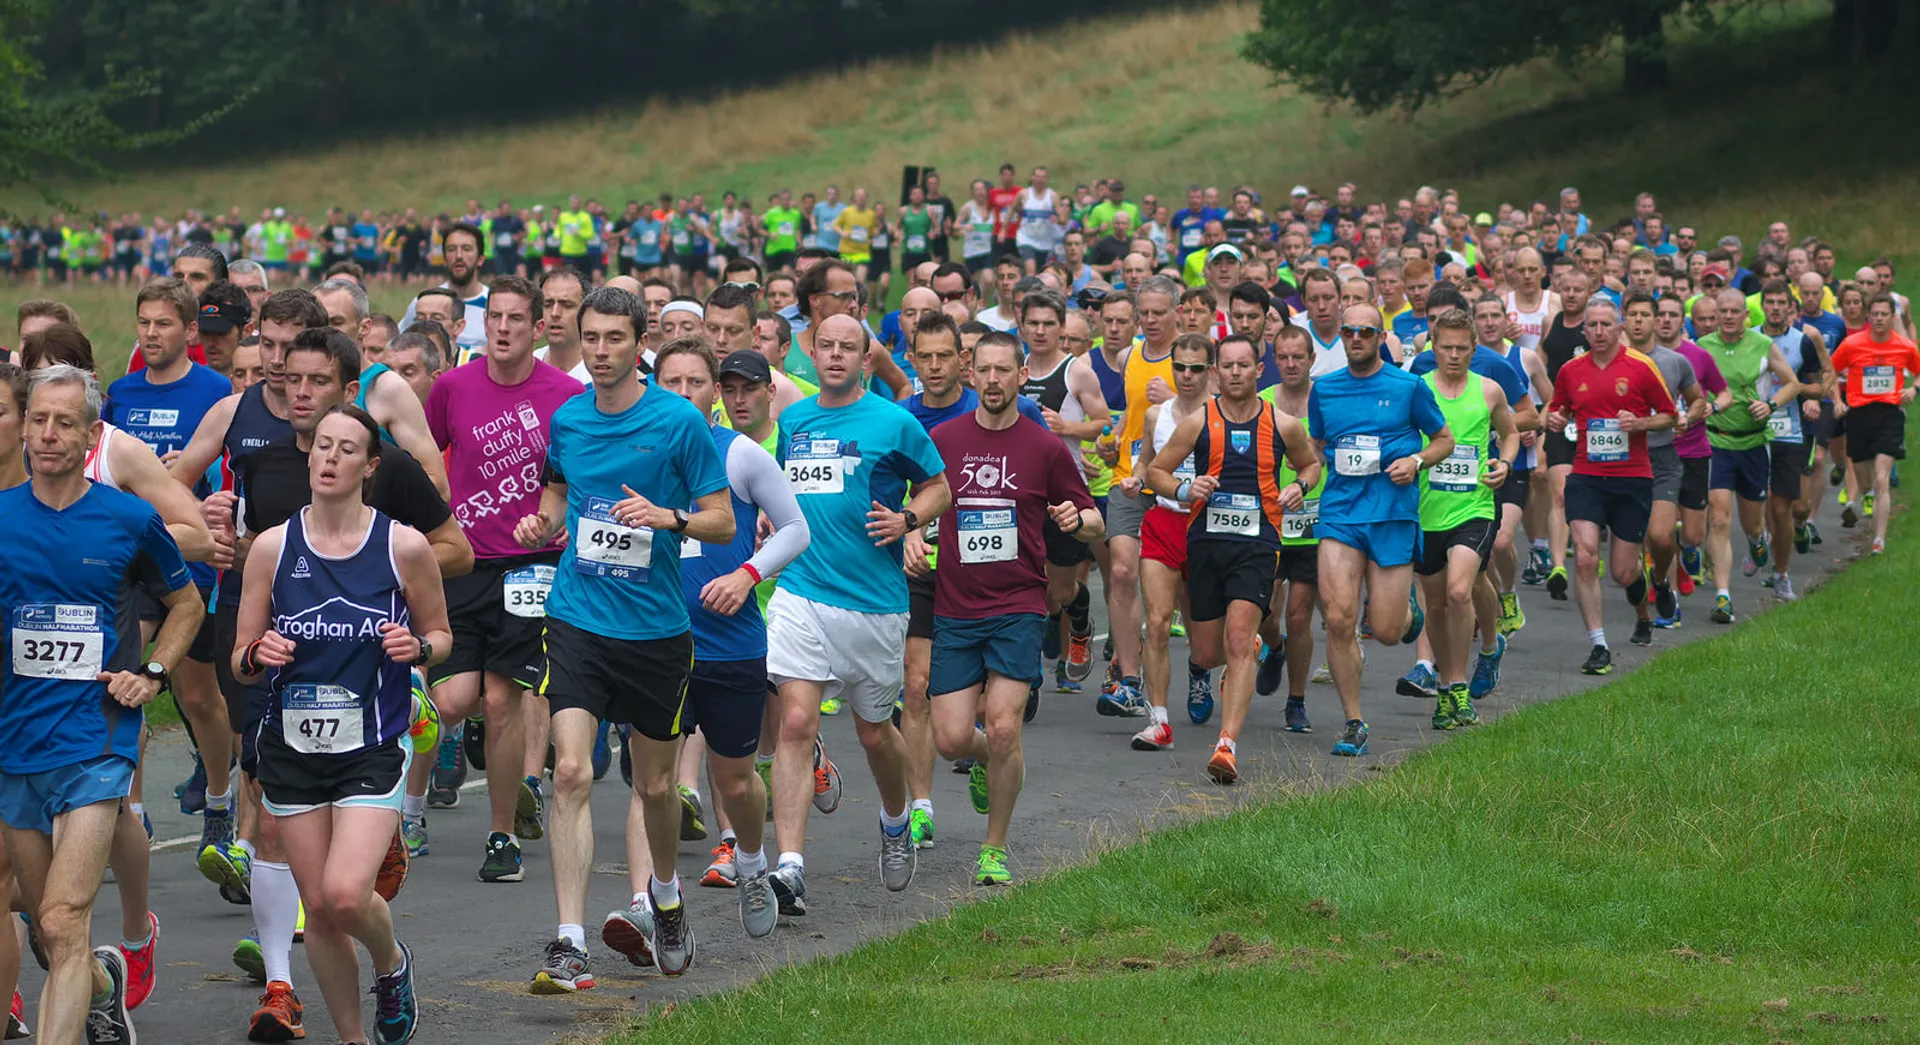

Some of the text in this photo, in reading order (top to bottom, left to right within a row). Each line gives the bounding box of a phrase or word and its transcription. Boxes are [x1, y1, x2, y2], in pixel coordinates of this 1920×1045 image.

[1867, 379, 1889, 388] 2812
[472, 410, 517, 441] frank
[483, 428, 522, 456] duffy
[1590, 434, 1622, 446] 6846
[478, 447, 531, 479] 10 mile
[962, 452, 1001, 462] donadea
[1347, 454, 1362, 466] 19
[790, 466, 832, 482] 3645
[1435, 462, 1469, 475] 5333
[1212, 513, 1251, 527] 7586
[591, 529, 631, 550] 495
[967, 535, 1003, 551] 698
[611, 568, 629, 578] 495
[511, 591, 546, 605] 335
[58, 608, 94, 617] DUBLIN
[277, 614, 353, 640] Croghan
[24, 639, 86, 662] 3277
[299, 718, 340, 737] 477
